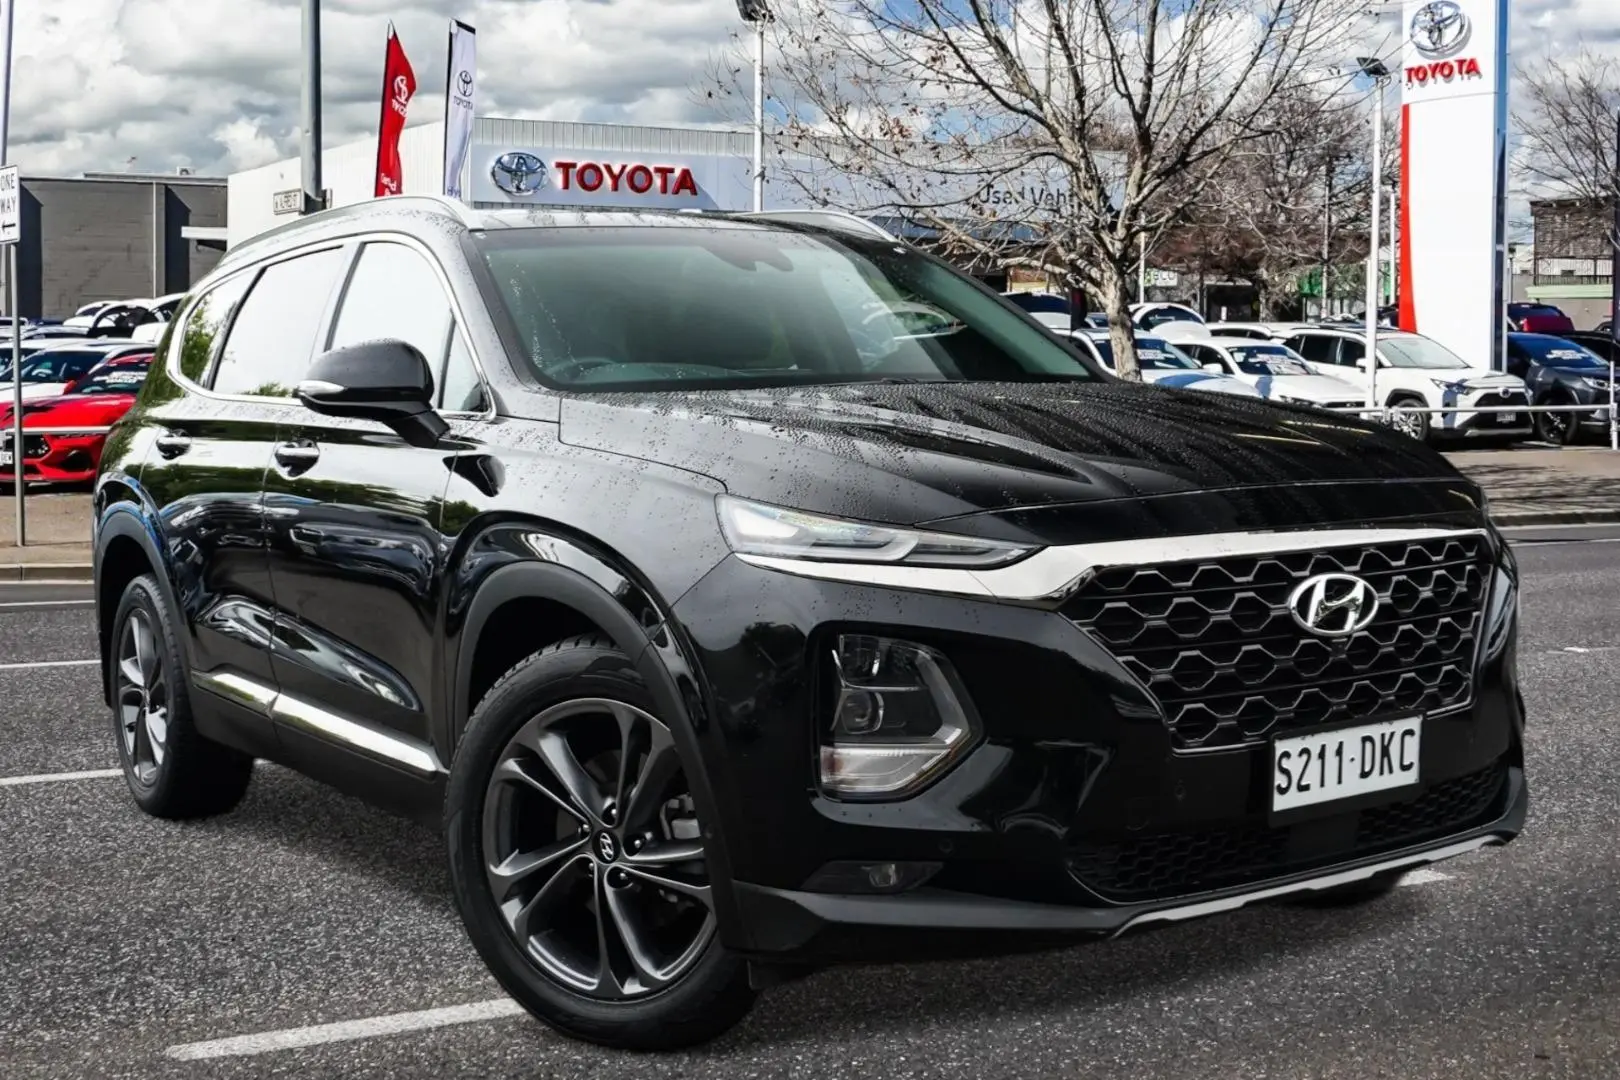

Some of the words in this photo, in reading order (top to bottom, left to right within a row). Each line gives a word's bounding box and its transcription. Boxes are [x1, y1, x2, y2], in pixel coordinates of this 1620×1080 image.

[1404, 58, 1481, 83] TOYOTA
[1, 173, 16, 191] ONE
[555, 161, 698, 196] TOYOTA
[1, 196, 16, 214] WAY
